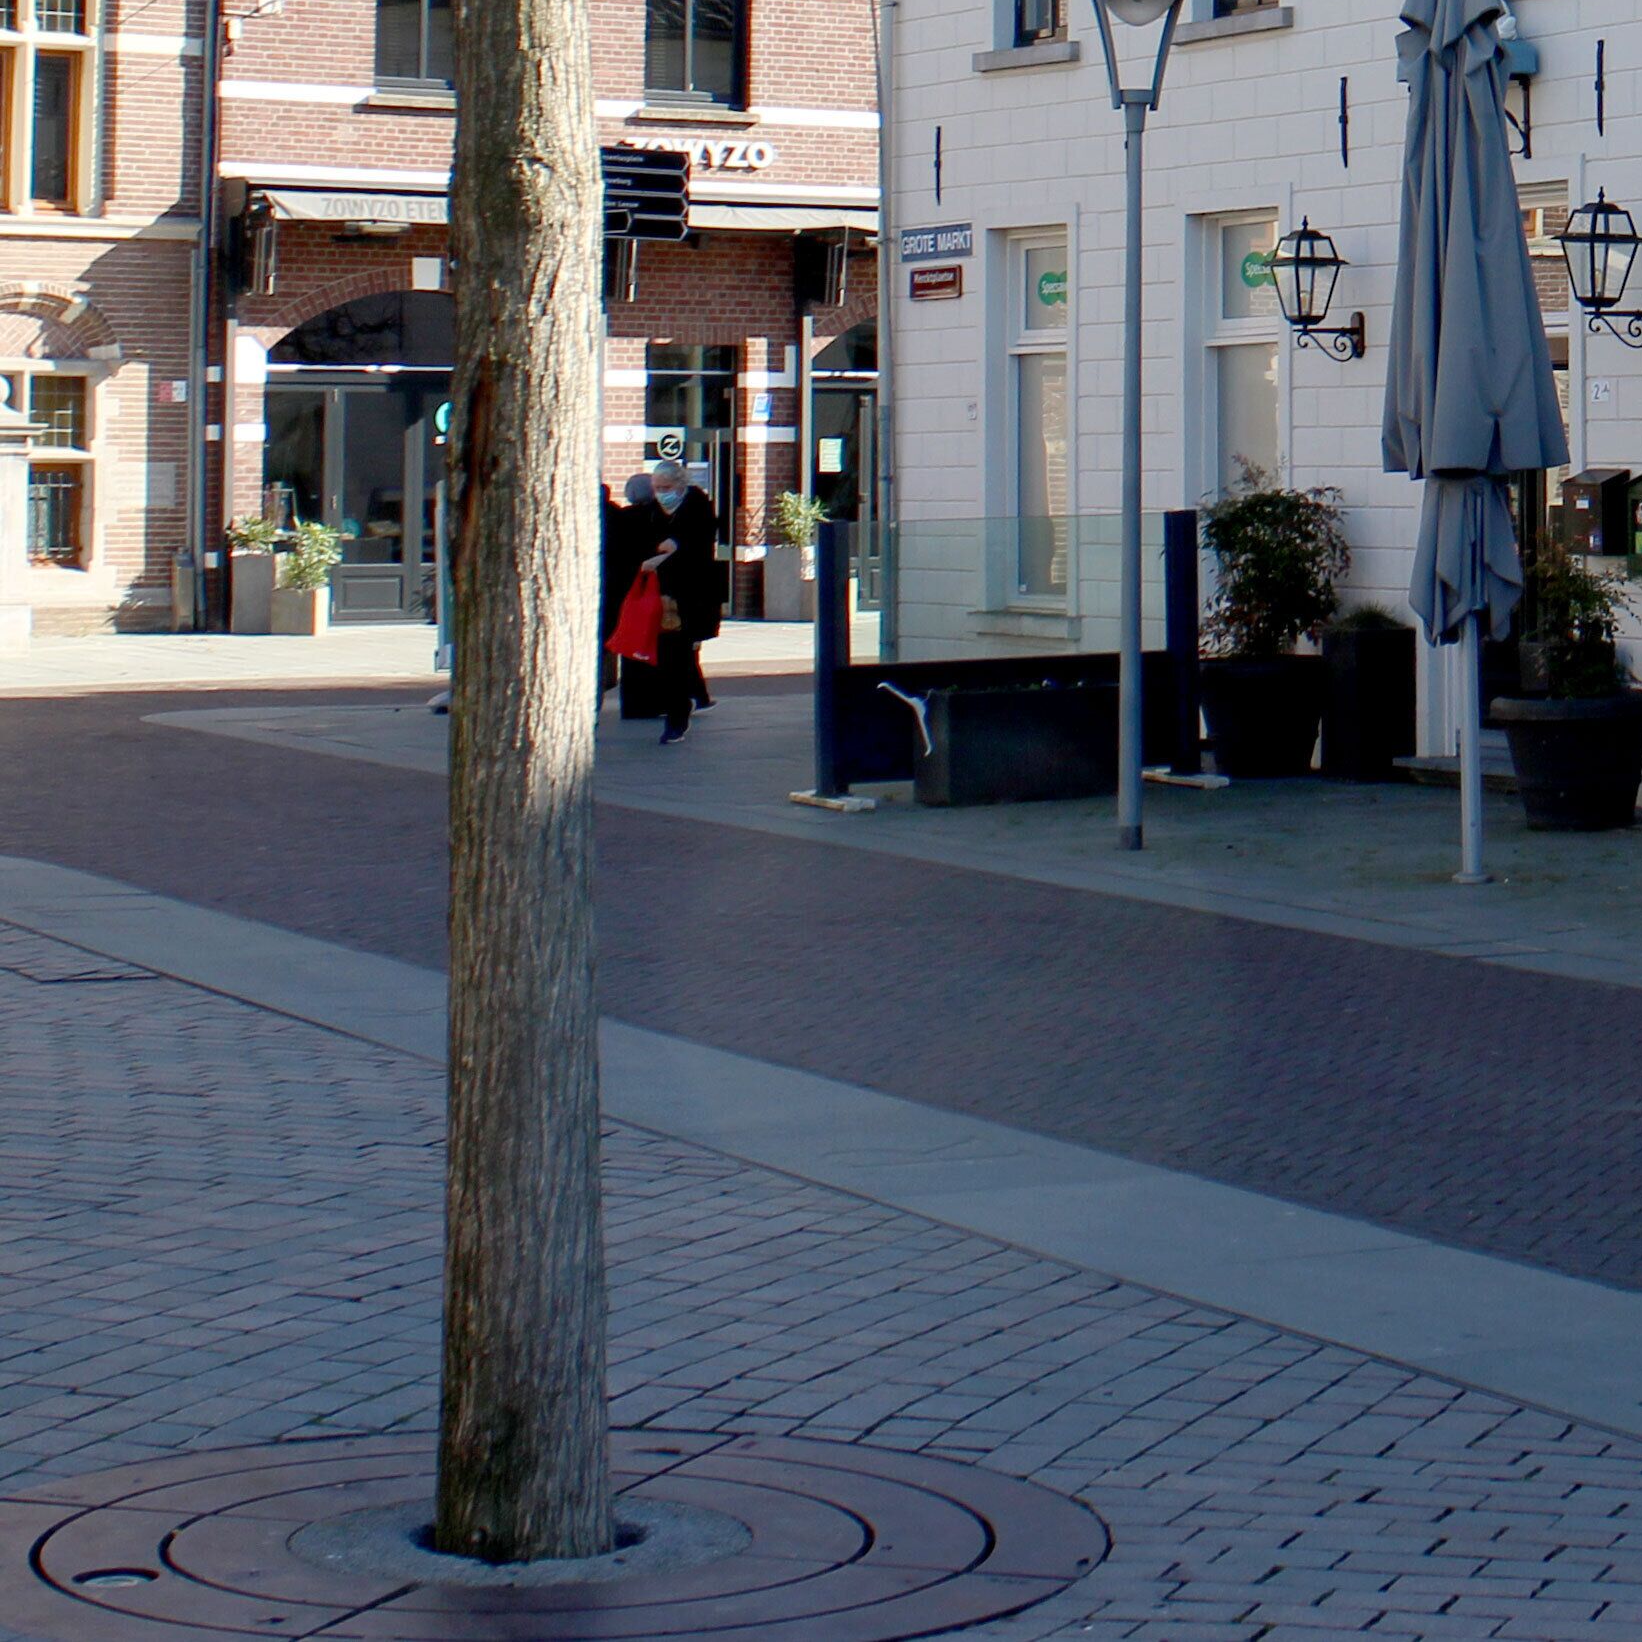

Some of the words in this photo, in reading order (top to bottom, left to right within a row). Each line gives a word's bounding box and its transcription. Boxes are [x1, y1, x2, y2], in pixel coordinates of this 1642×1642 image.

[320, 196, 401, 219] ZOWYZO
[902, 233, 935, 255] GROTE
[937, 229, 972, 252] MARKT
